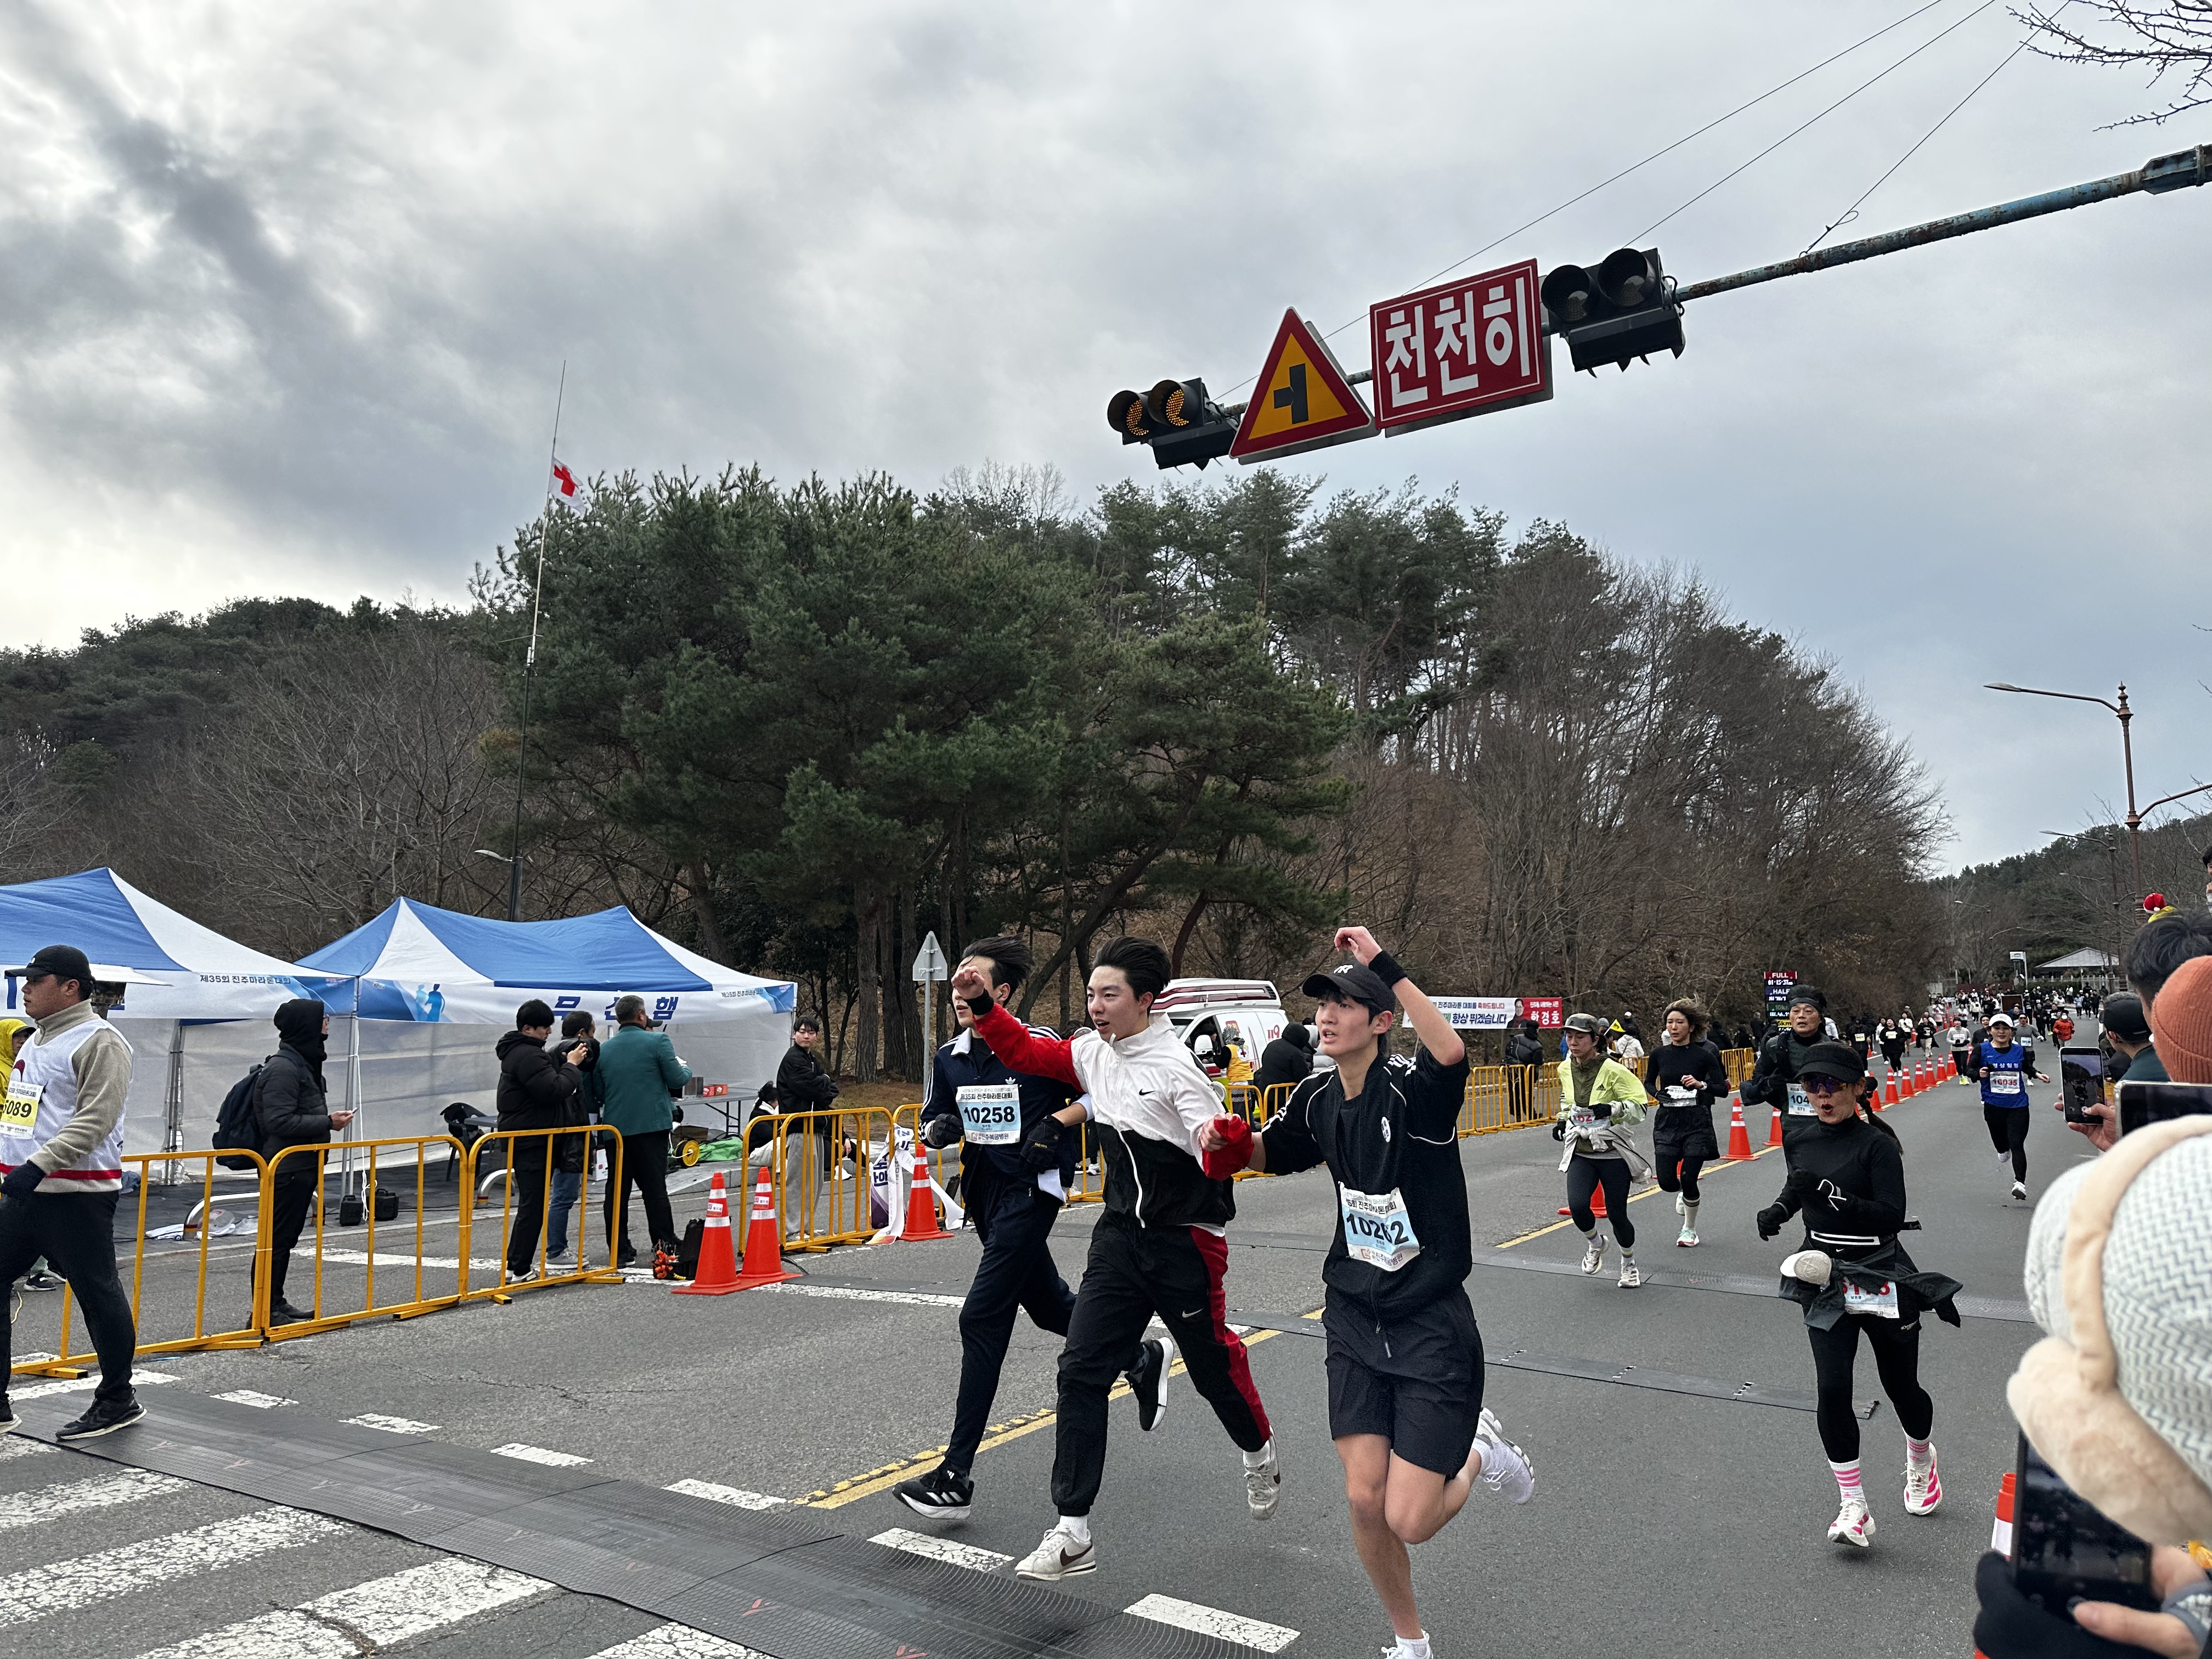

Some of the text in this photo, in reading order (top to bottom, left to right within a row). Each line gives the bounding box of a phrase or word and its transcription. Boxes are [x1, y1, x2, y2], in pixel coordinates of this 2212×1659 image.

[1385, 277, 1530, 408] 천천히
[200, 974, 291, 985] 제35회 진주마라톤대회
[1452, 1013, 1469, 1024] 항상
[1469, 1013, 1507, 1025] 뛰겠습니다
[1267, 1024, 1280, 1039] 119
[963, 1106, 1015, 1124] 10258
[981, 1132, 1009, 1141] 진주복음병원
[1346, 1213, 1409, 1245] 10262
